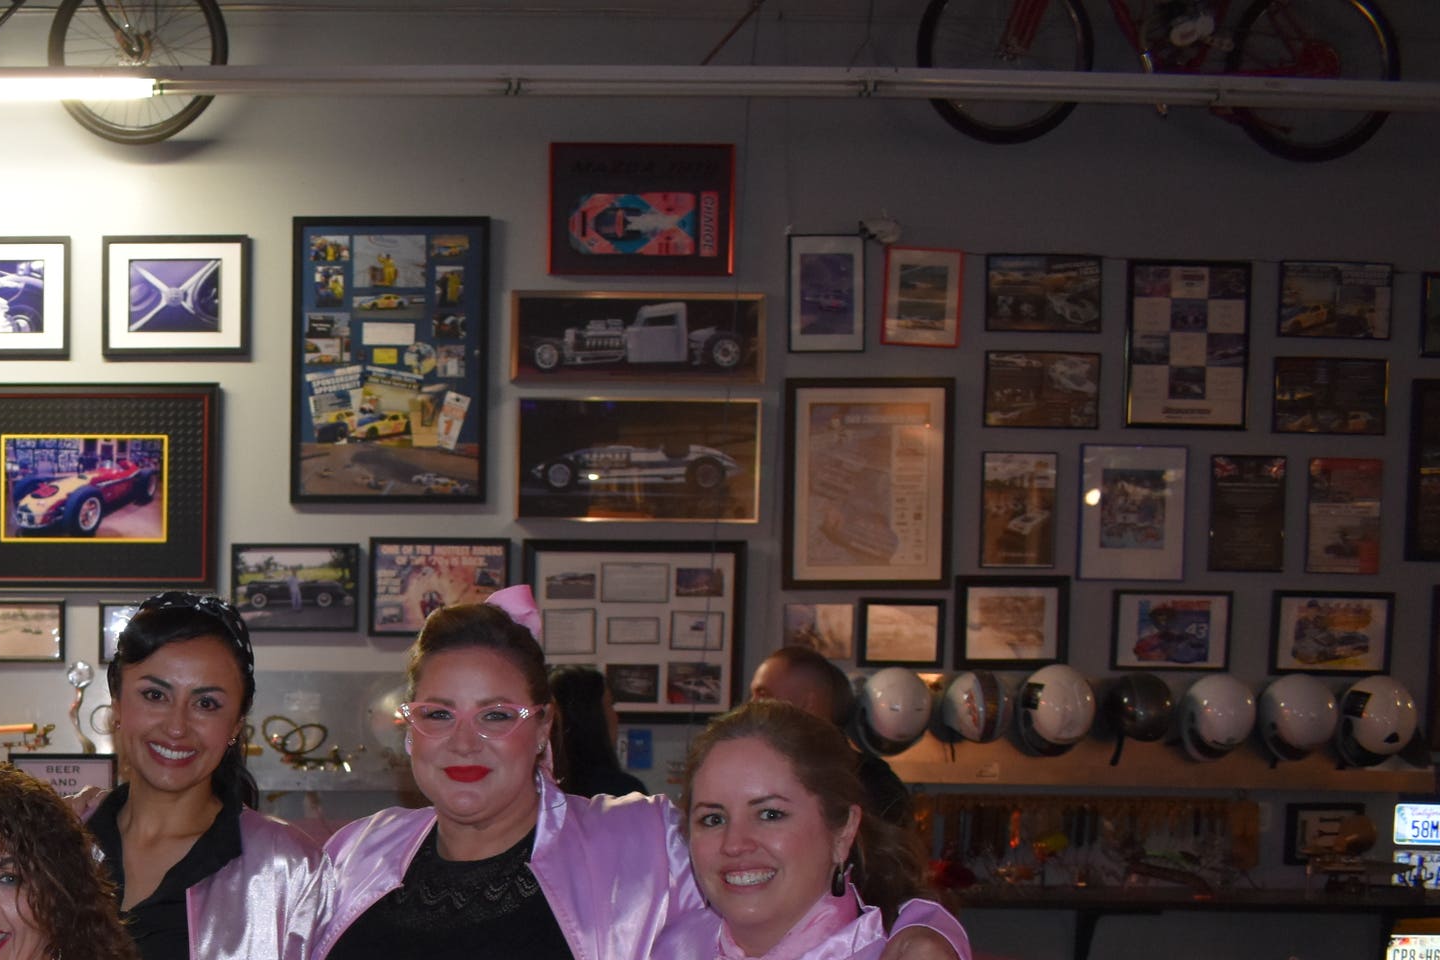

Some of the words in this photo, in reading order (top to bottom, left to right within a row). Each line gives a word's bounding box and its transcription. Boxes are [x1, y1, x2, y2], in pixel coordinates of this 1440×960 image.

[1185, 622, 1209, 639] 43
[45, 765, 81, 774] BEER
[50, 778, 77, 787] AND
[1411, 820, 1440, 839] 58M
